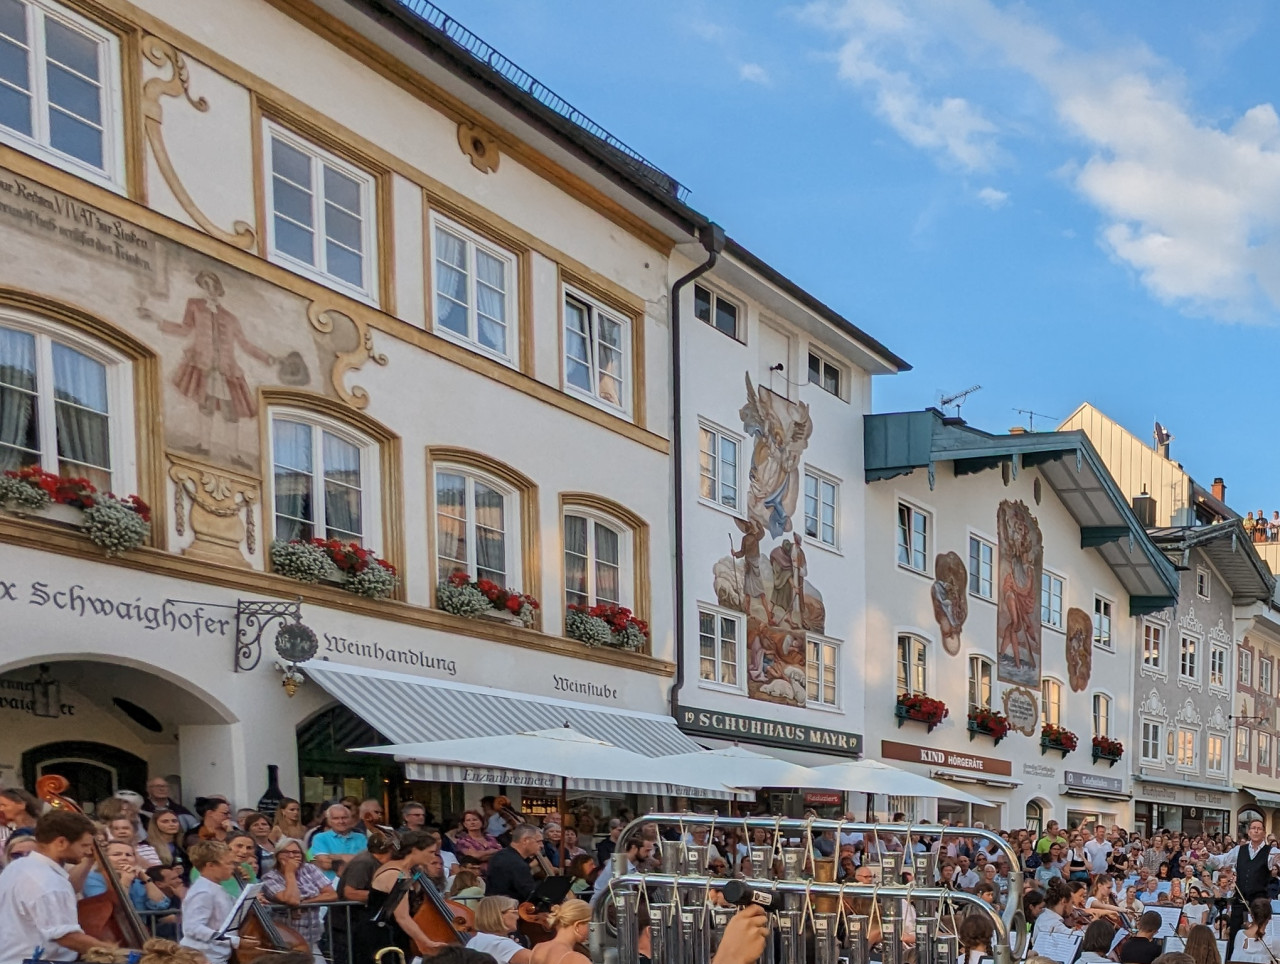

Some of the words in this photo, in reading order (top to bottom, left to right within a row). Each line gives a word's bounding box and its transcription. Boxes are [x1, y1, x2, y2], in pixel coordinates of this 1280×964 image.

[54, 196, 96, 227] VIVAT
[29, 581, 230, 637] Schwaighofer
[324, 633, 457, 676] Weinhandlung
[685, 712, 695, 723] 19
[699, 712, 805, 741] SCHUHHAUS
[809, 730, 848, 749] MAYR
[849, 737, 857, 748] 19
[920, 749, 945, 763] KIND
[948, 755, 983, 770] HÖRGERÄTE
[462, 768, 555, 787] Enzianbrennerei
